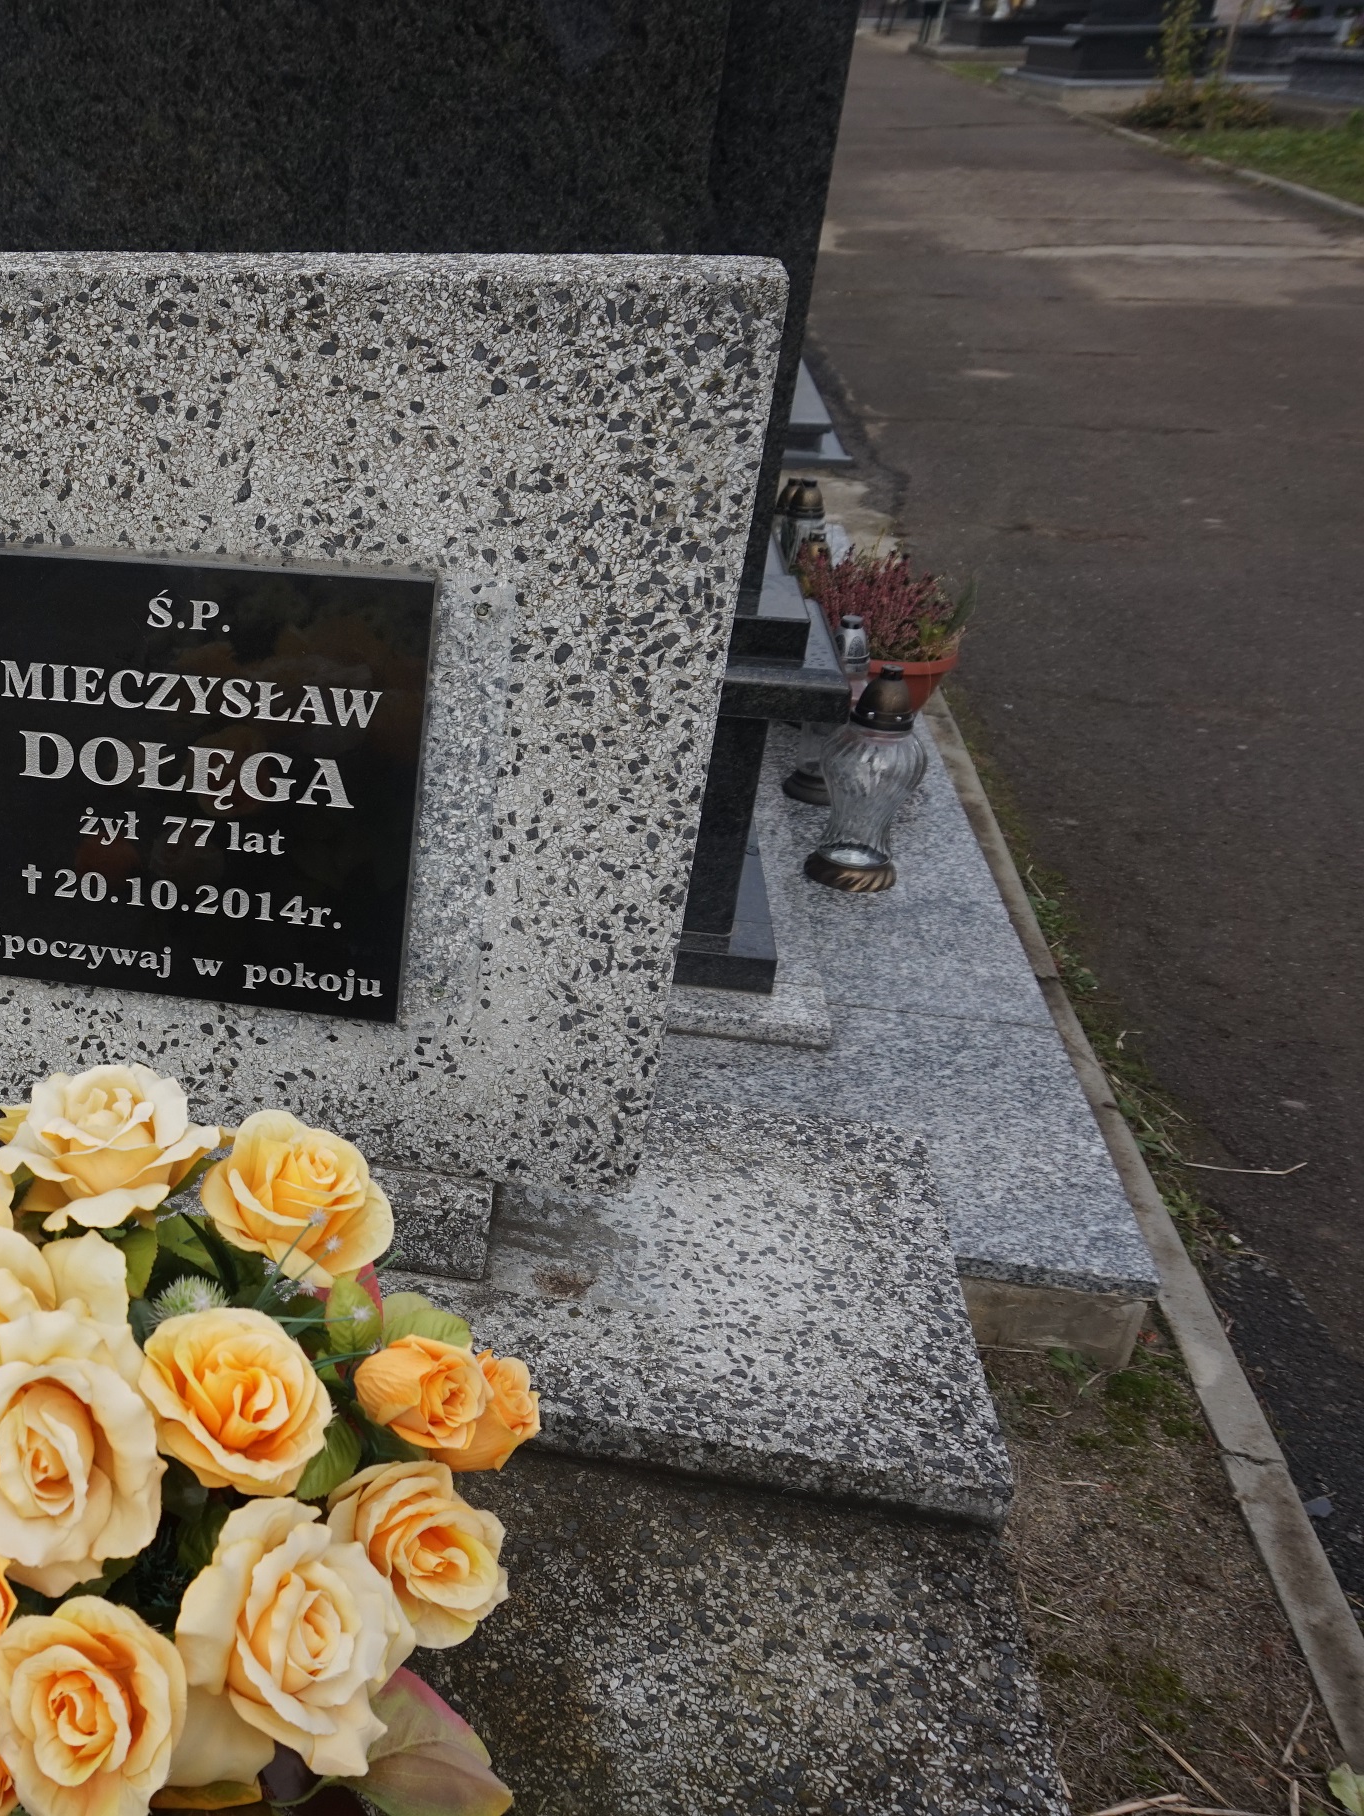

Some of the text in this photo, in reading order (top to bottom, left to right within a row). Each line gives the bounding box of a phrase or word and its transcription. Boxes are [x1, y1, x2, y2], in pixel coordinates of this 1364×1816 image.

[146, 589, 231, 633] Ś.P.
[0, 659, 384, 729] MIECZYSŁAW
[18, 730, 355, 811] DOŁĘGA
[79, 807, 286, 856] żył 77 lat
[53, 868, 344, 931] 20.10.2014r.
[192, 953, 224, 978] w
[242, 962, 385, 1002] pokoju
